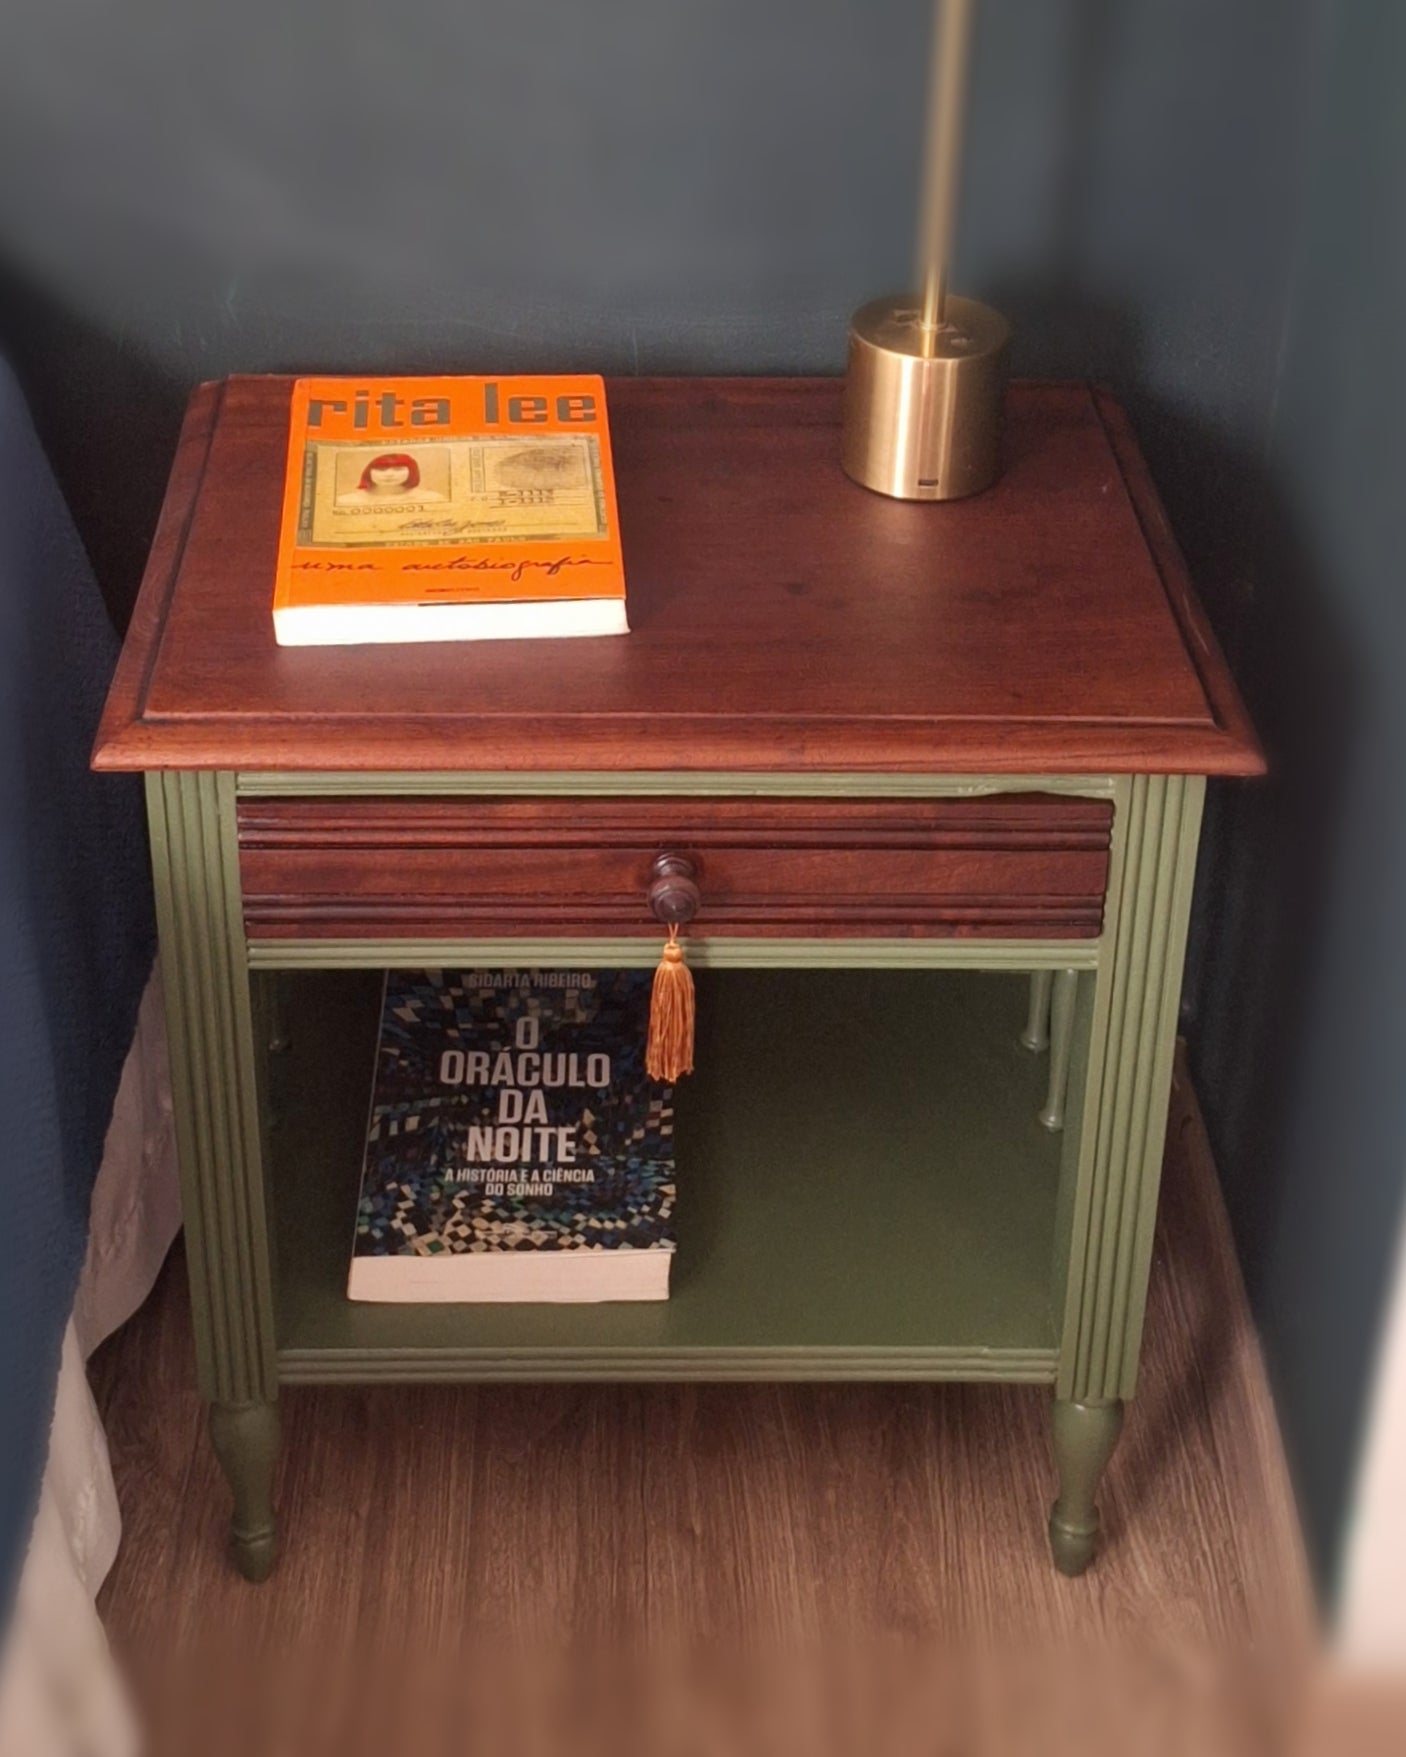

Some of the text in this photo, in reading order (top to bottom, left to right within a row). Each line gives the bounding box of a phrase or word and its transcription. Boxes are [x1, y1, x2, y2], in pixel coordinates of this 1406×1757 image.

[308, 383, 597, 428] rita lee
[401, 555, 613, 581] autobiografia
[533, 973, 592, 989] RIBEIRO
[515, 1016, 540, 1050] O
[439, 1046, 611, 1088] ORÁCULO
[499, 1088, 548, 1125] DA
[466, 1126, 576, 1163] NOITE
[444, 1167, 595, 1182] A HISTÓRIA E A CIÊNCIA
[485, 1183, 553, 1196] DO SONHO
